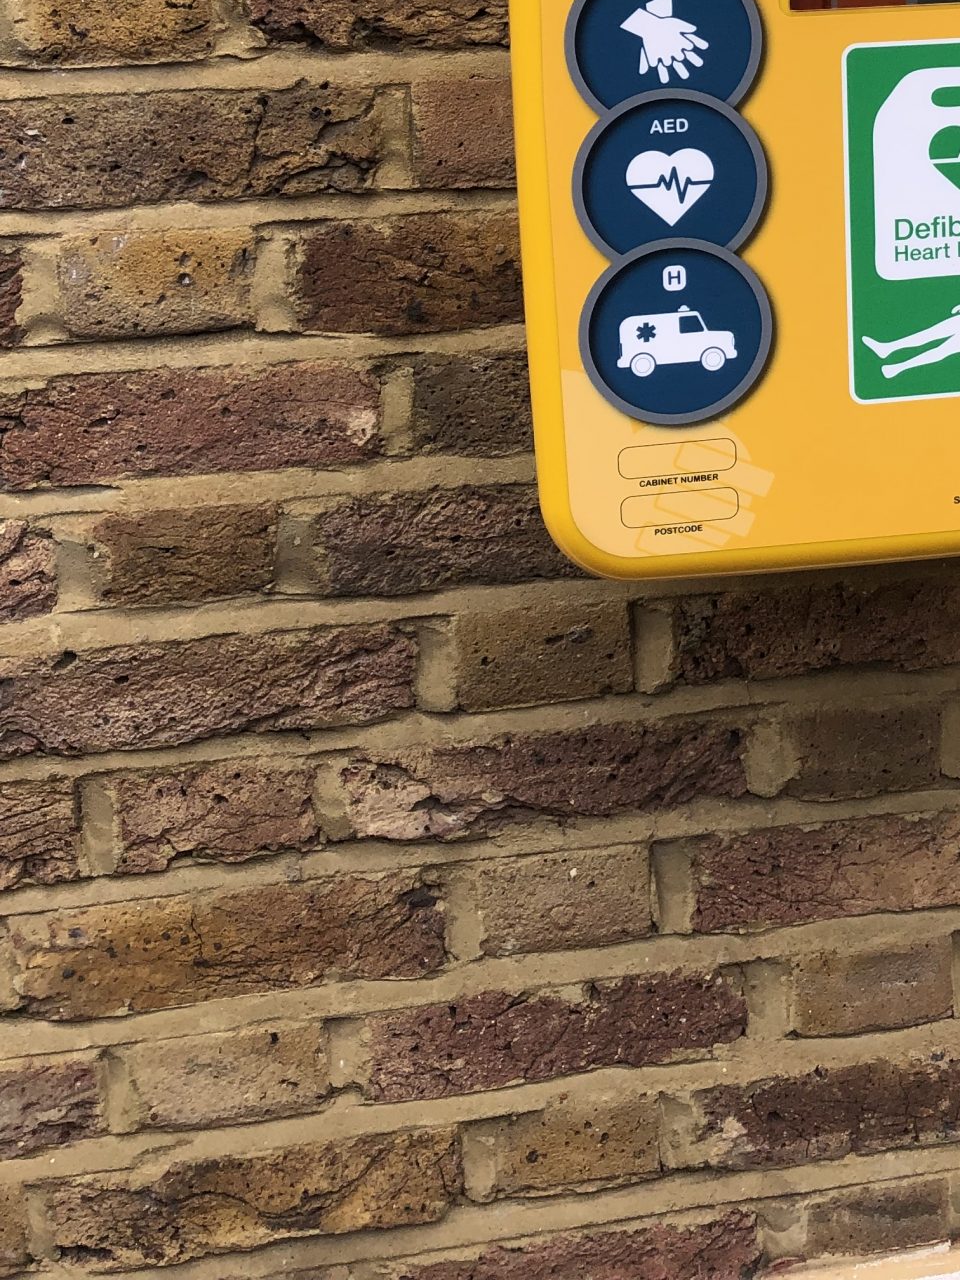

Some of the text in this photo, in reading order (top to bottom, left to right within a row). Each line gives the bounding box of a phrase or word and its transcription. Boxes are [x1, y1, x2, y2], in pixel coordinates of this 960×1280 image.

[649, 118, 689, 134] AED
[894, 243, 951, 262] Heart
[667, 270, 682, 286] H
[639, 473, 719, 488] CABINET NUMBER
[654, 524, 704, 536] POSTCODE
